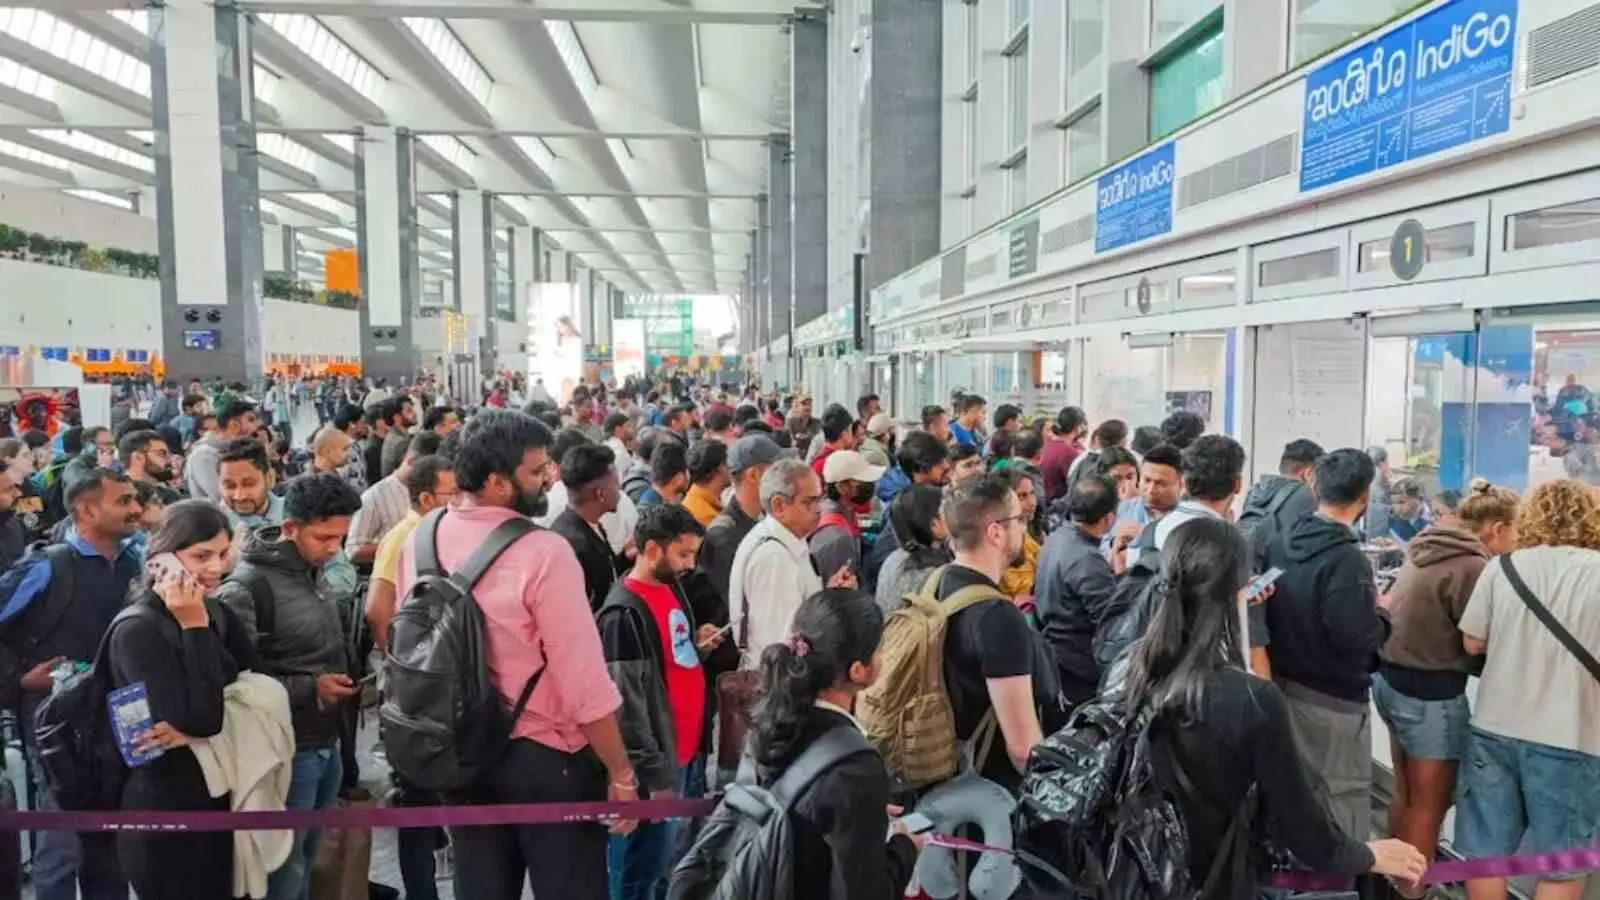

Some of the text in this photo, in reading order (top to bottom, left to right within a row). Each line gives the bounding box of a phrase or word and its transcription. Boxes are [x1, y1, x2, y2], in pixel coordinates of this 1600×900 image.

[1416, 12, 1510, 79] IndiGo
[1139, 161, 1173, 193] IndiGo
[1403, 236, 1412, 264] 1
